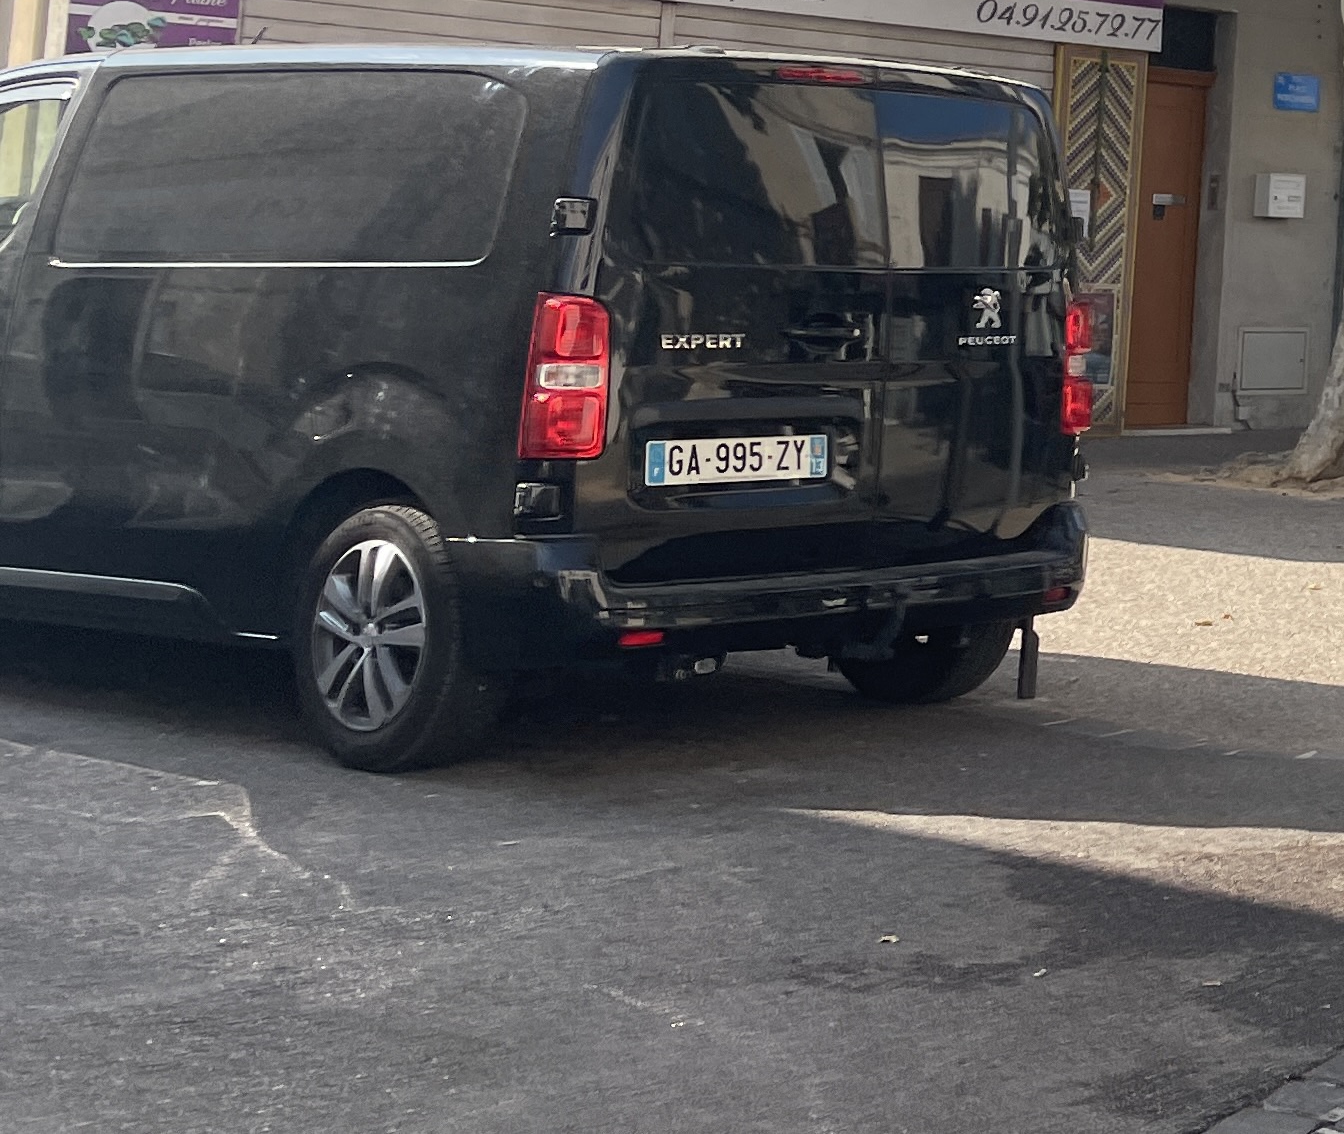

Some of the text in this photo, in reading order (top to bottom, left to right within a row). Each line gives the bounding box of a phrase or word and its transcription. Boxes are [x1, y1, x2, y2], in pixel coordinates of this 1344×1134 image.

[660, 332, 747, 350] EXPERT
[957, 335, 1017, 346] PEUGEOT
[668, 439, 806, 476] GA-995-ZY
